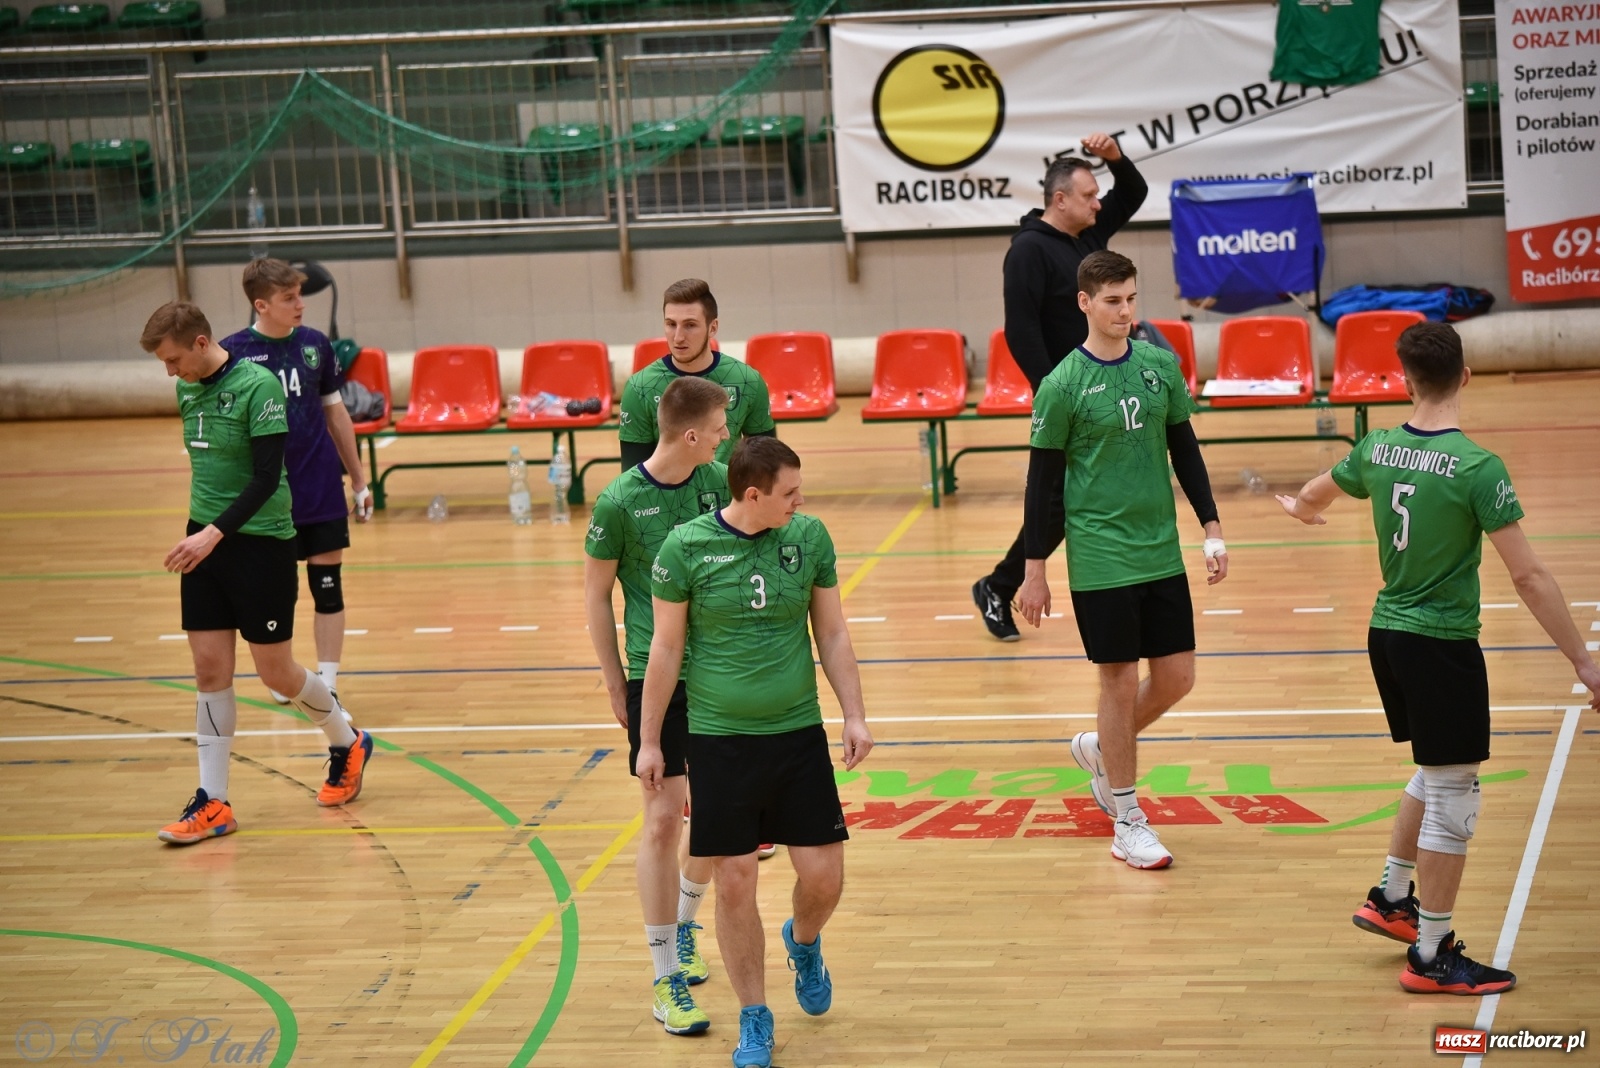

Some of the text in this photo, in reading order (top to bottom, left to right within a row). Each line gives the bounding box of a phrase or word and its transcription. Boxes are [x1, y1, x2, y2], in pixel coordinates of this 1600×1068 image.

[1511, 4, 1600, 25] AWARYJ
[1513, 31, 1570, 50] ORAZ
[1514, 60, 1597, 83] Sprzedaż
[1514, 85, 1596, 103] (oferujemy
[1137, 114, 1175, 151] W
[1516, 136, 1596, 158] i pilotów
[877, 174, 1012, 204] RACIBÓRZ
[1197, 228, 1297, 256] molten
[1522, 265, 1600, 287] Racibórz
[278, 367, 302, 398] 14
[1119, 396, 1143, 431] 12
[1371, 443, 1460, 478] WŁODOWICE
[1391, 482, 1416, 552] 5
[712, 554, 735, 563] VIGO
[749, 574, 766, 610] 3
